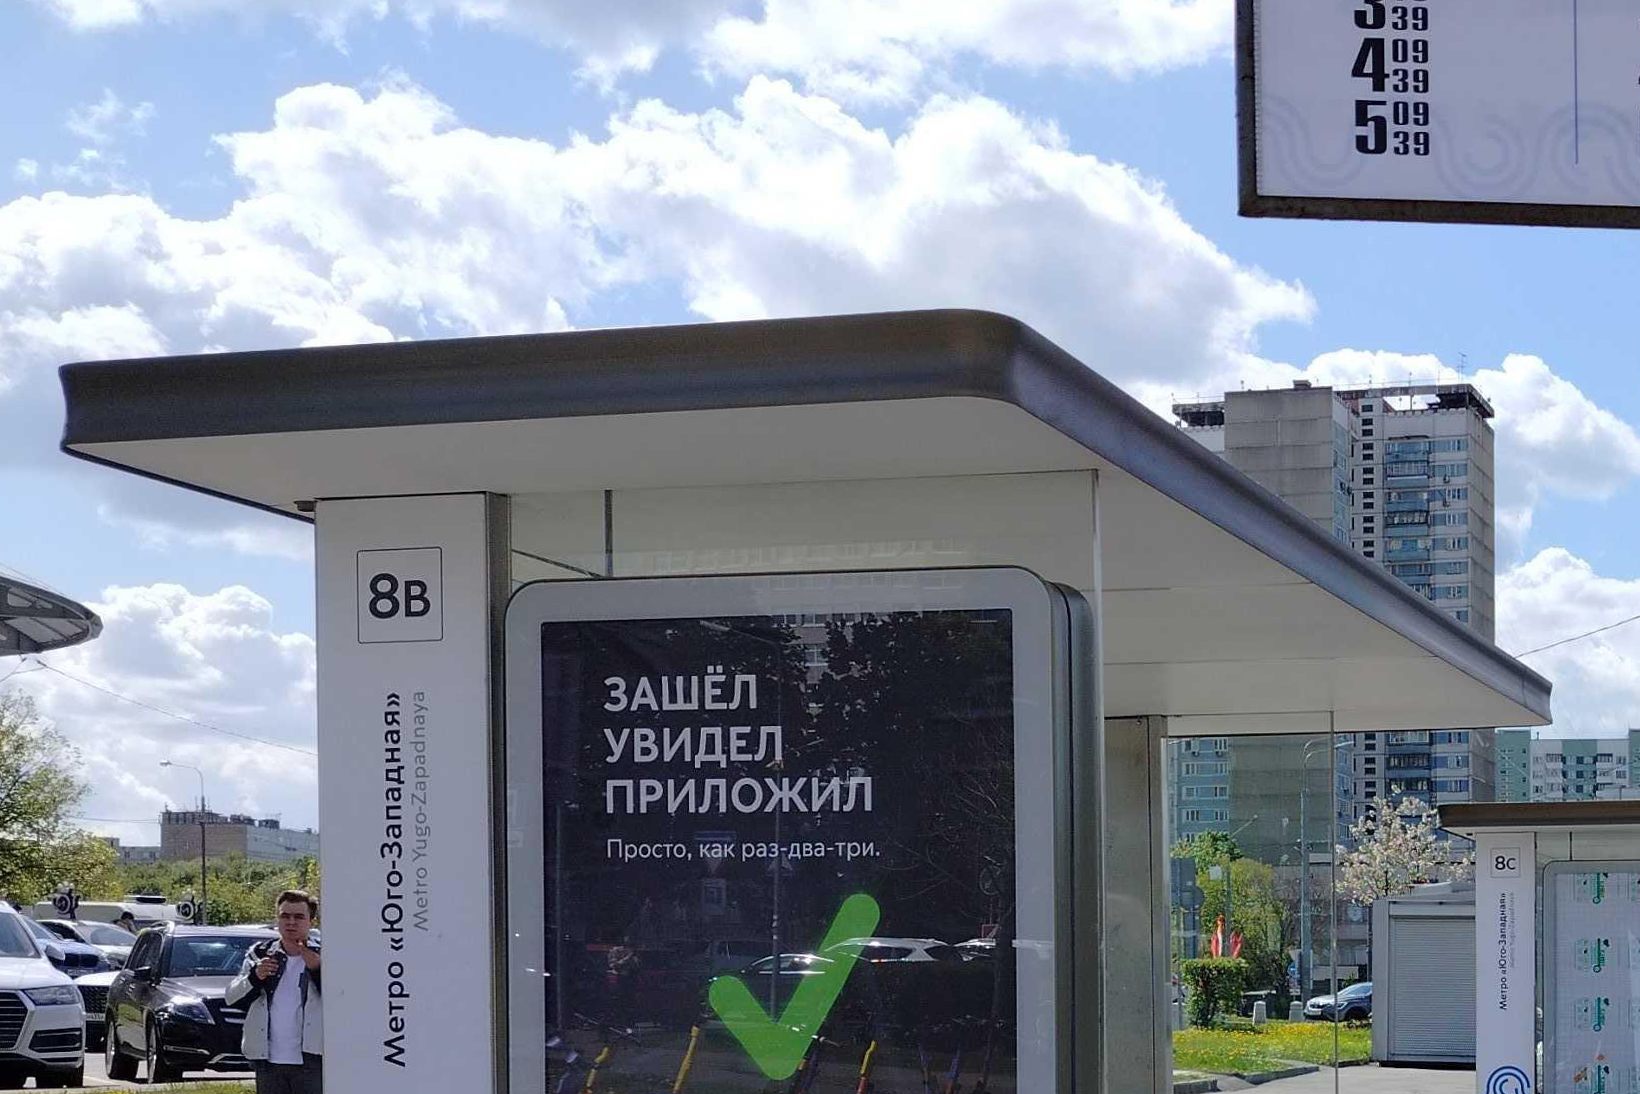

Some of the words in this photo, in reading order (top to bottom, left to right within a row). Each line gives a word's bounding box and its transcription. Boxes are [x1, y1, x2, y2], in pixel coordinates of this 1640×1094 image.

[1391, 6, 1429, 31] 39
[1351, 37, 1390, 92] 4
[1392, 38, 1429, 64] 09
[1392, 68, 1429, 94] 39
[1355, 99, 1388, 155] 5
[1393, 101, 1429, 126] 09
[1393, 131, 1430, 156] 39
[603, 665, 757, 712] ЗАШЁЛ
[604, 725, 783, 769] УВИДЕЛ
[411, 690, 432, 867] Yugo-Zapadnaya
[605, 776, 873, 814] ПРИЛОЖИЛ
[379, 691, 407, 952] «Юго-Западная»
[606, 838, 693, 861] Просто,
[699, 841, 736, 858] как
[742, 840, 881, 862] раз-два-три.
[412, 868, 430, 931] Metro
[382, 961, 411, 1067] Метро
[1499, 977, 1509, 1011] Метро
